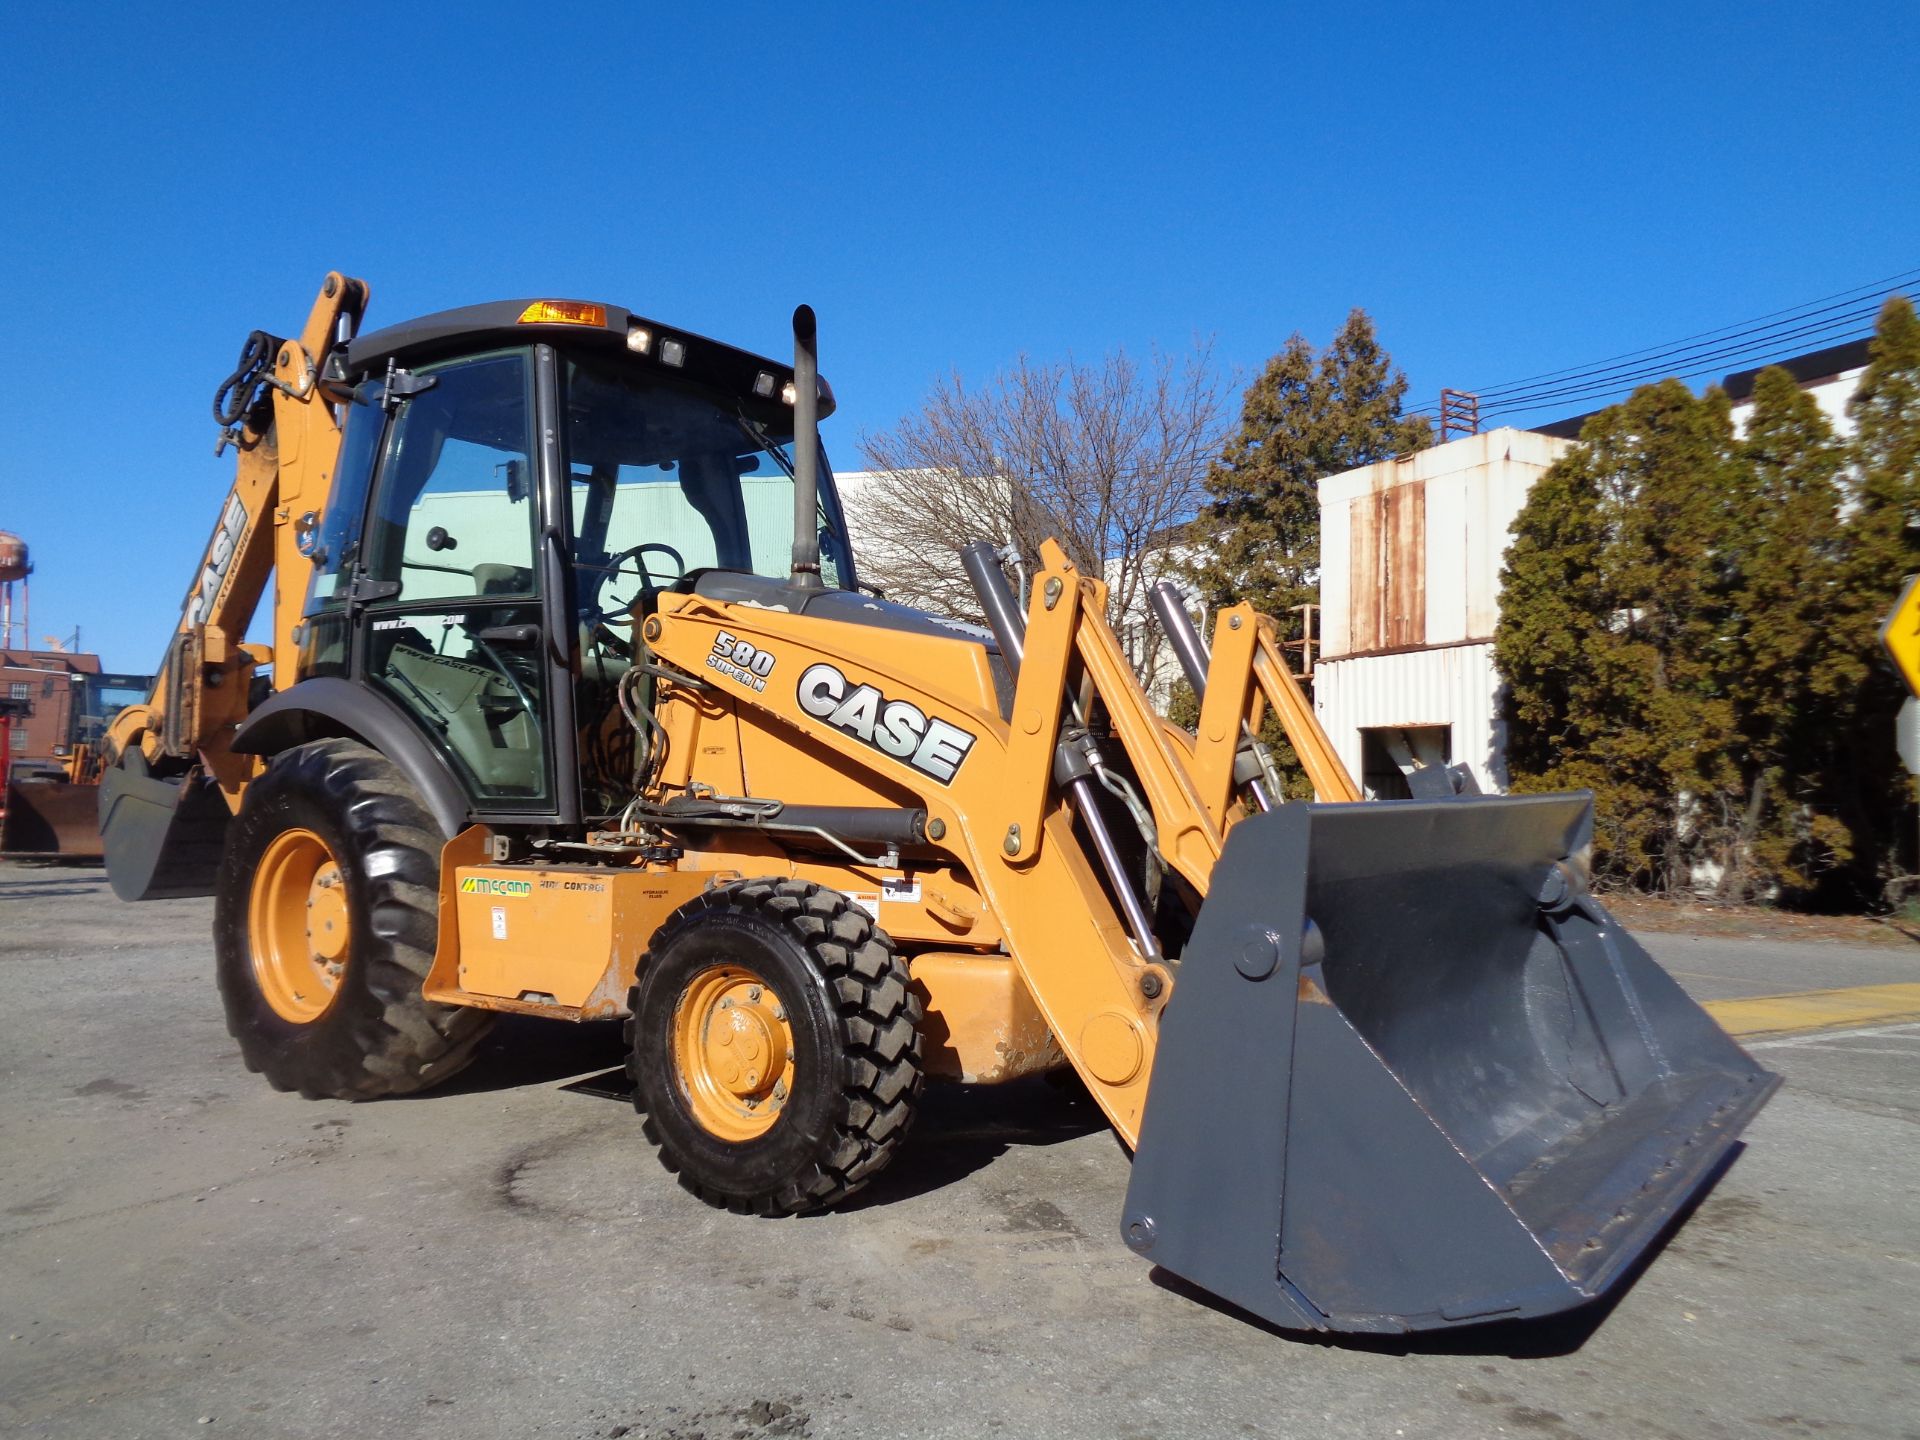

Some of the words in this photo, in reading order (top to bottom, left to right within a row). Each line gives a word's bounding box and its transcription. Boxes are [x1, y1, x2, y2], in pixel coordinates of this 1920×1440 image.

[706, 654, 753, 686] SUPER
[750, 675, 767, 693] N
[712, 630, 776, 677] 580
[797, 662, 977, 785] CASE
